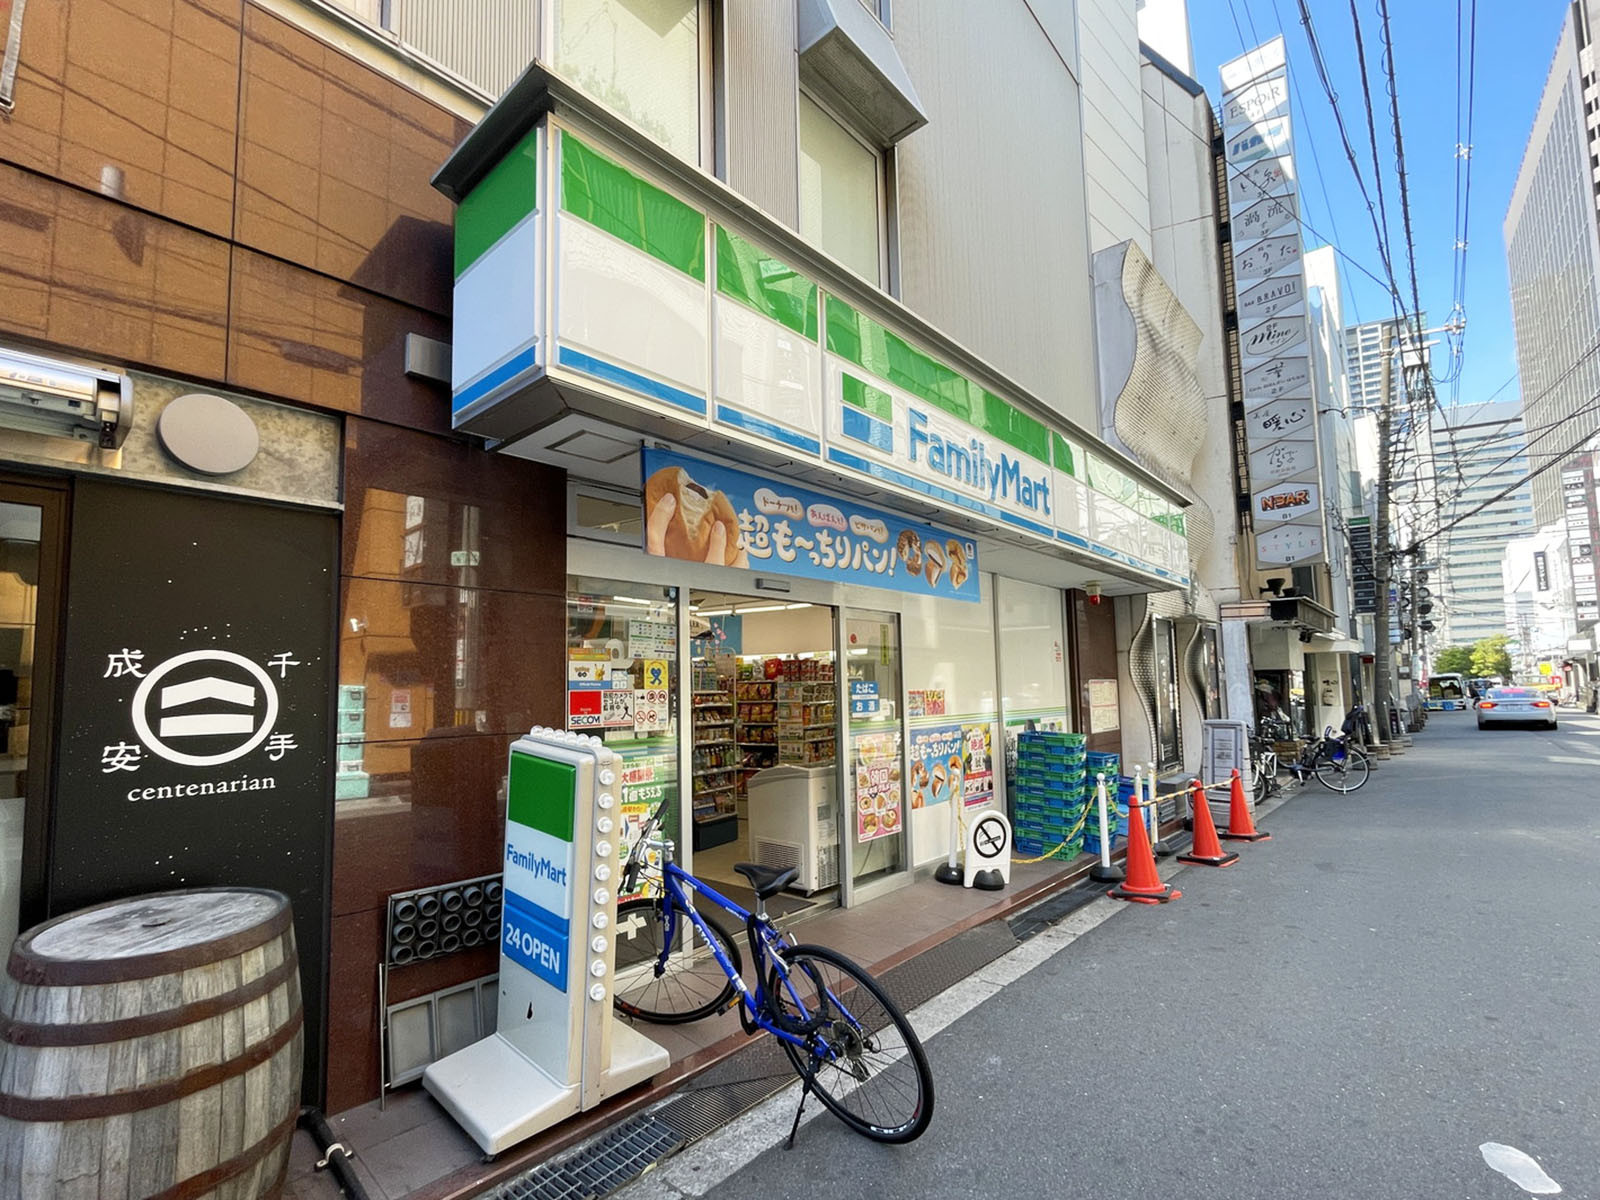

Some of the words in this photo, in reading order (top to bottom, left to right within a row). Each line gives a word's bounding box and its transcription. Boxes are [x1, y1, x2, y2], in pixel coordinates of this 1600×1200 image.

[1257, 281, 1296, 303] BRAVO!
[907, 406, 1051, 516] FamilyMart
[103, 648, 147, 678] 成
[267, 652, 301, 678] 千
[855, 683, 875, 694] たばこ
[571, 716, 600, 725] SECOM
[101, 741, 142, 773] 安
[264, 731, 299, 761] 手
[127, 774, 276, 801] centenarian
[506, 843, 567, 887] FamilyMart
